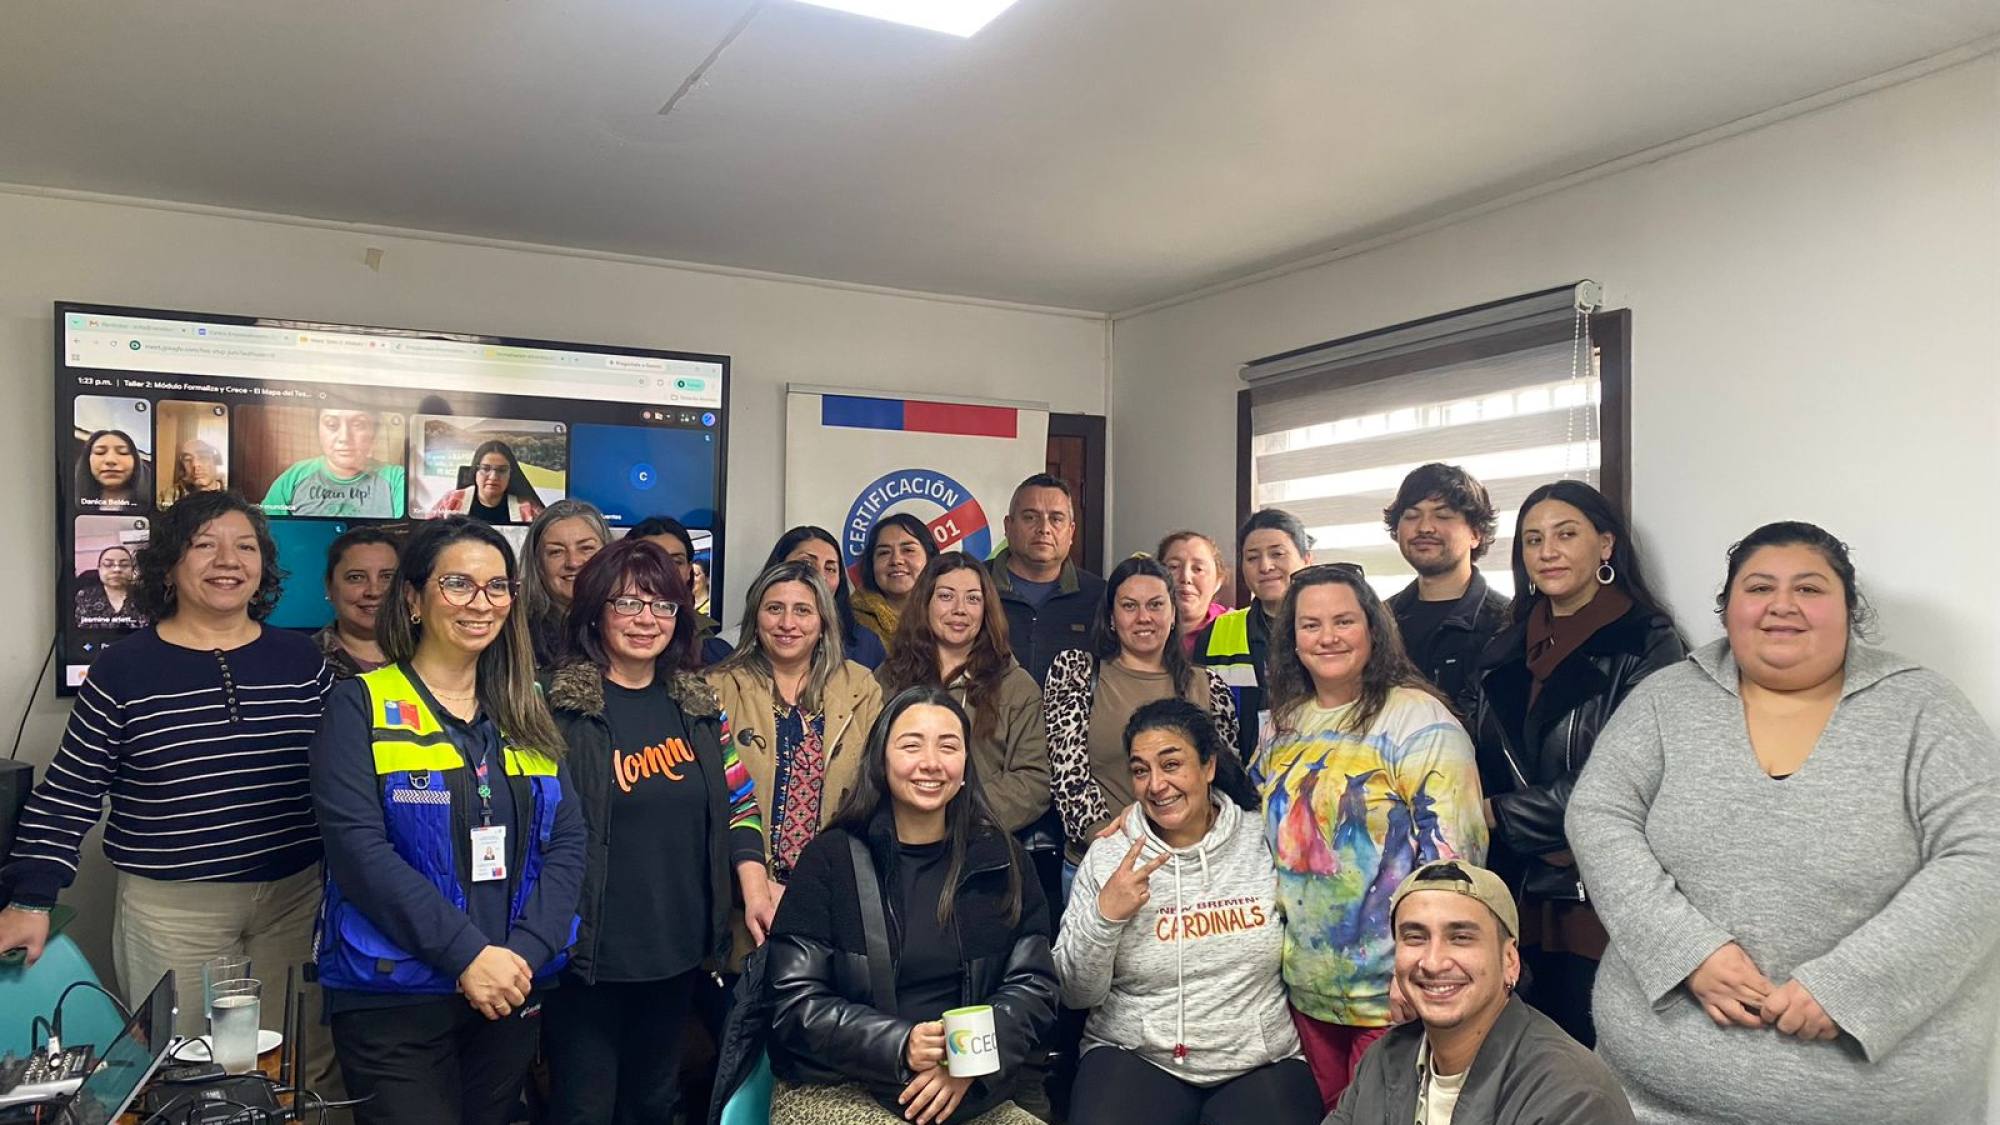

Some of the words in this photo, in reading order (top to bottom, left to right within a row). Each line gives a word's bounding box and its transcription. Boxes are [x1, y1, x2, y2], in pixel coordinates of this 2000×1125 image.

[78, 376, 93, 385] 1:23
[95, 379, 112, 387] p.m.
[124, 379, 144, 388] Taller
[154, 380, 182, 391] Módulo
[184, 383, 219, 392] Formaliza
[226, 385, 248, 394] Crece
[254, 387, 261, 395] El
[262, 388, 281, 397] Mapa
[282, 389, 294, 397] del
[640, 472, 648, 480] C
[309, 485, 345, 500] Clean
[81, 498, 107, 506] Danica
[108, 498, 130, 506] Belén
[850, 477, 959, 557] CERTIFICACIÓN
[933, 519, 962, 544] 01
[80, 615, 110, 625] jasmine
[1156, 905, 1266, 941] CARDINALS
